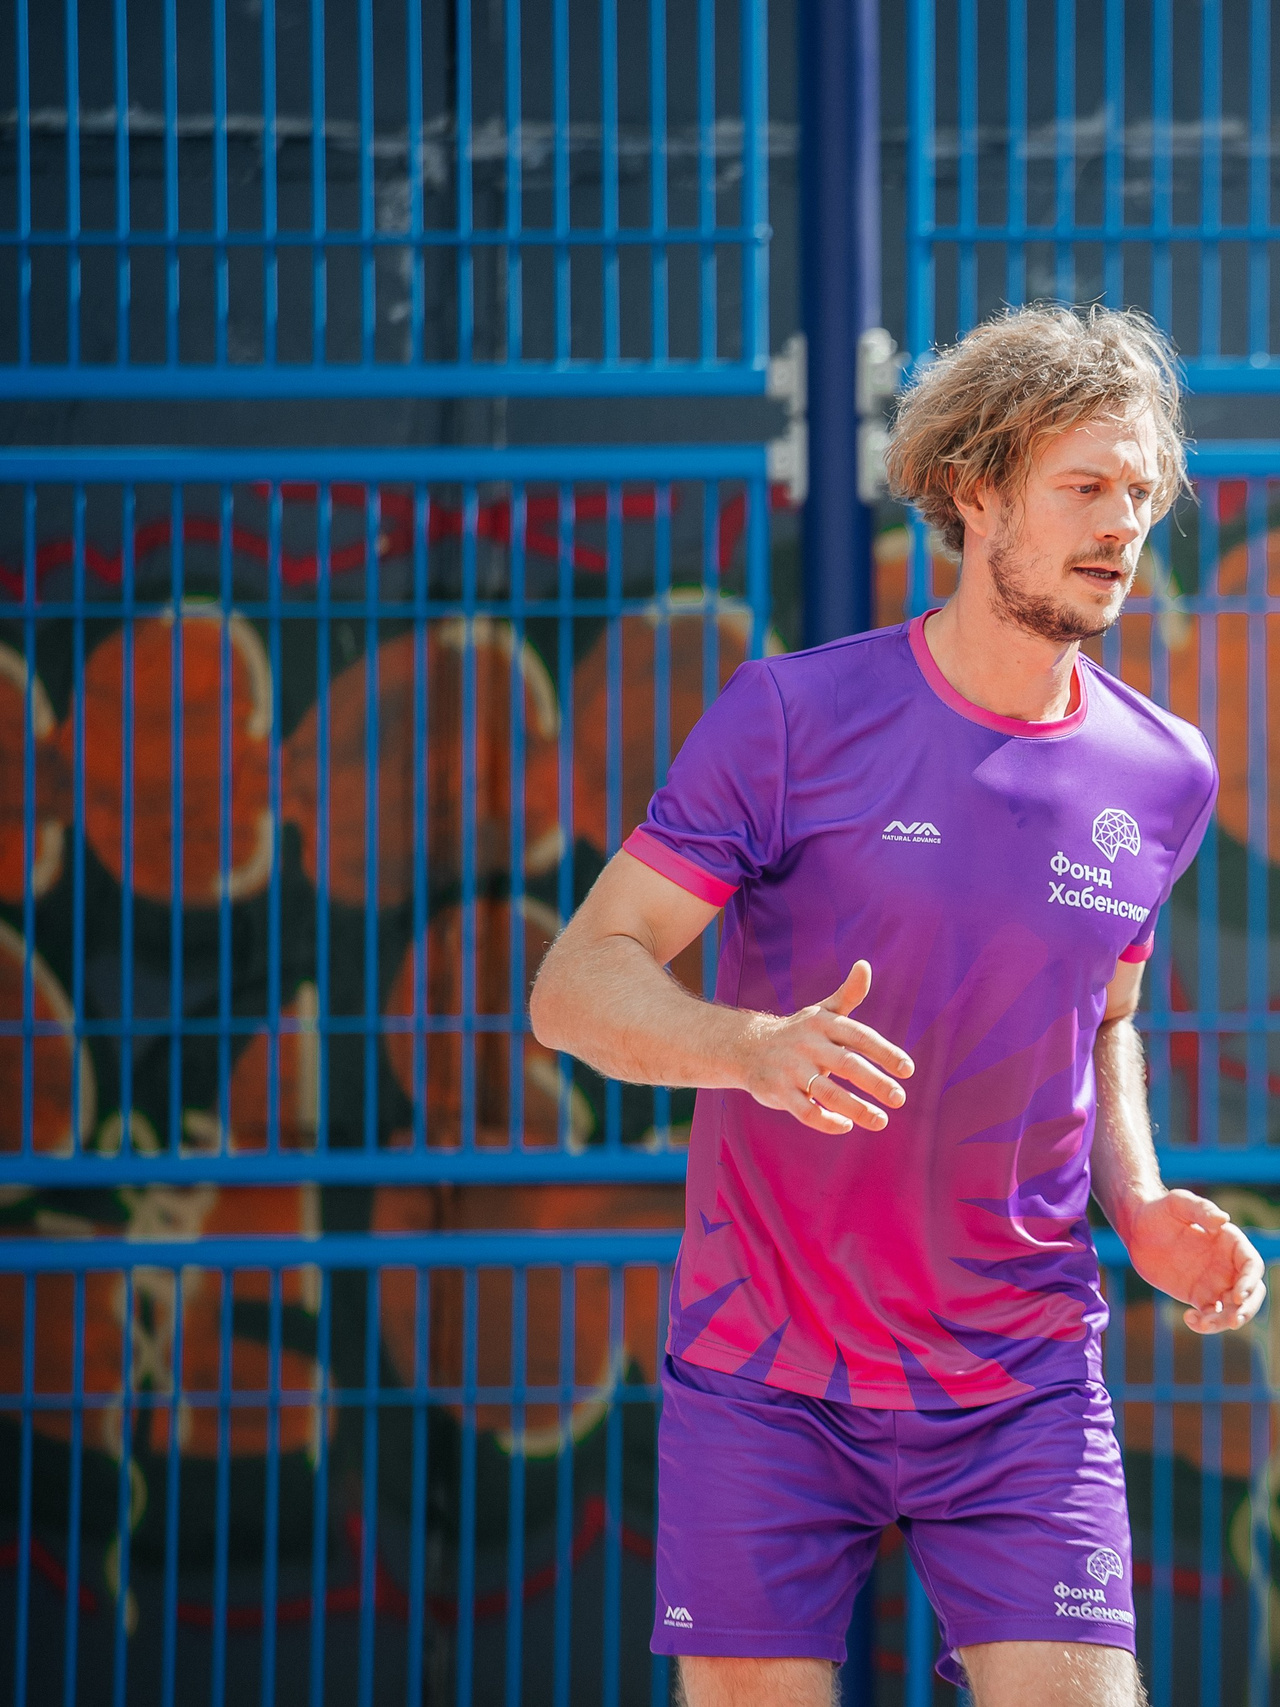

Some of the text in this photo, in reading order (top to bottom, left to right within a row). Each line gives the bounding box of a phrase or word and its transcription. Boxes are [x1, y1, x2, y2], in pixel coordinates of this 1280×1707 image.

[881, 834, 942, 844] NATURAL ADVANCE
[1049, 850, 1113, 889] Фонд
[1053, 1581, 1107, 1603] Фонд
